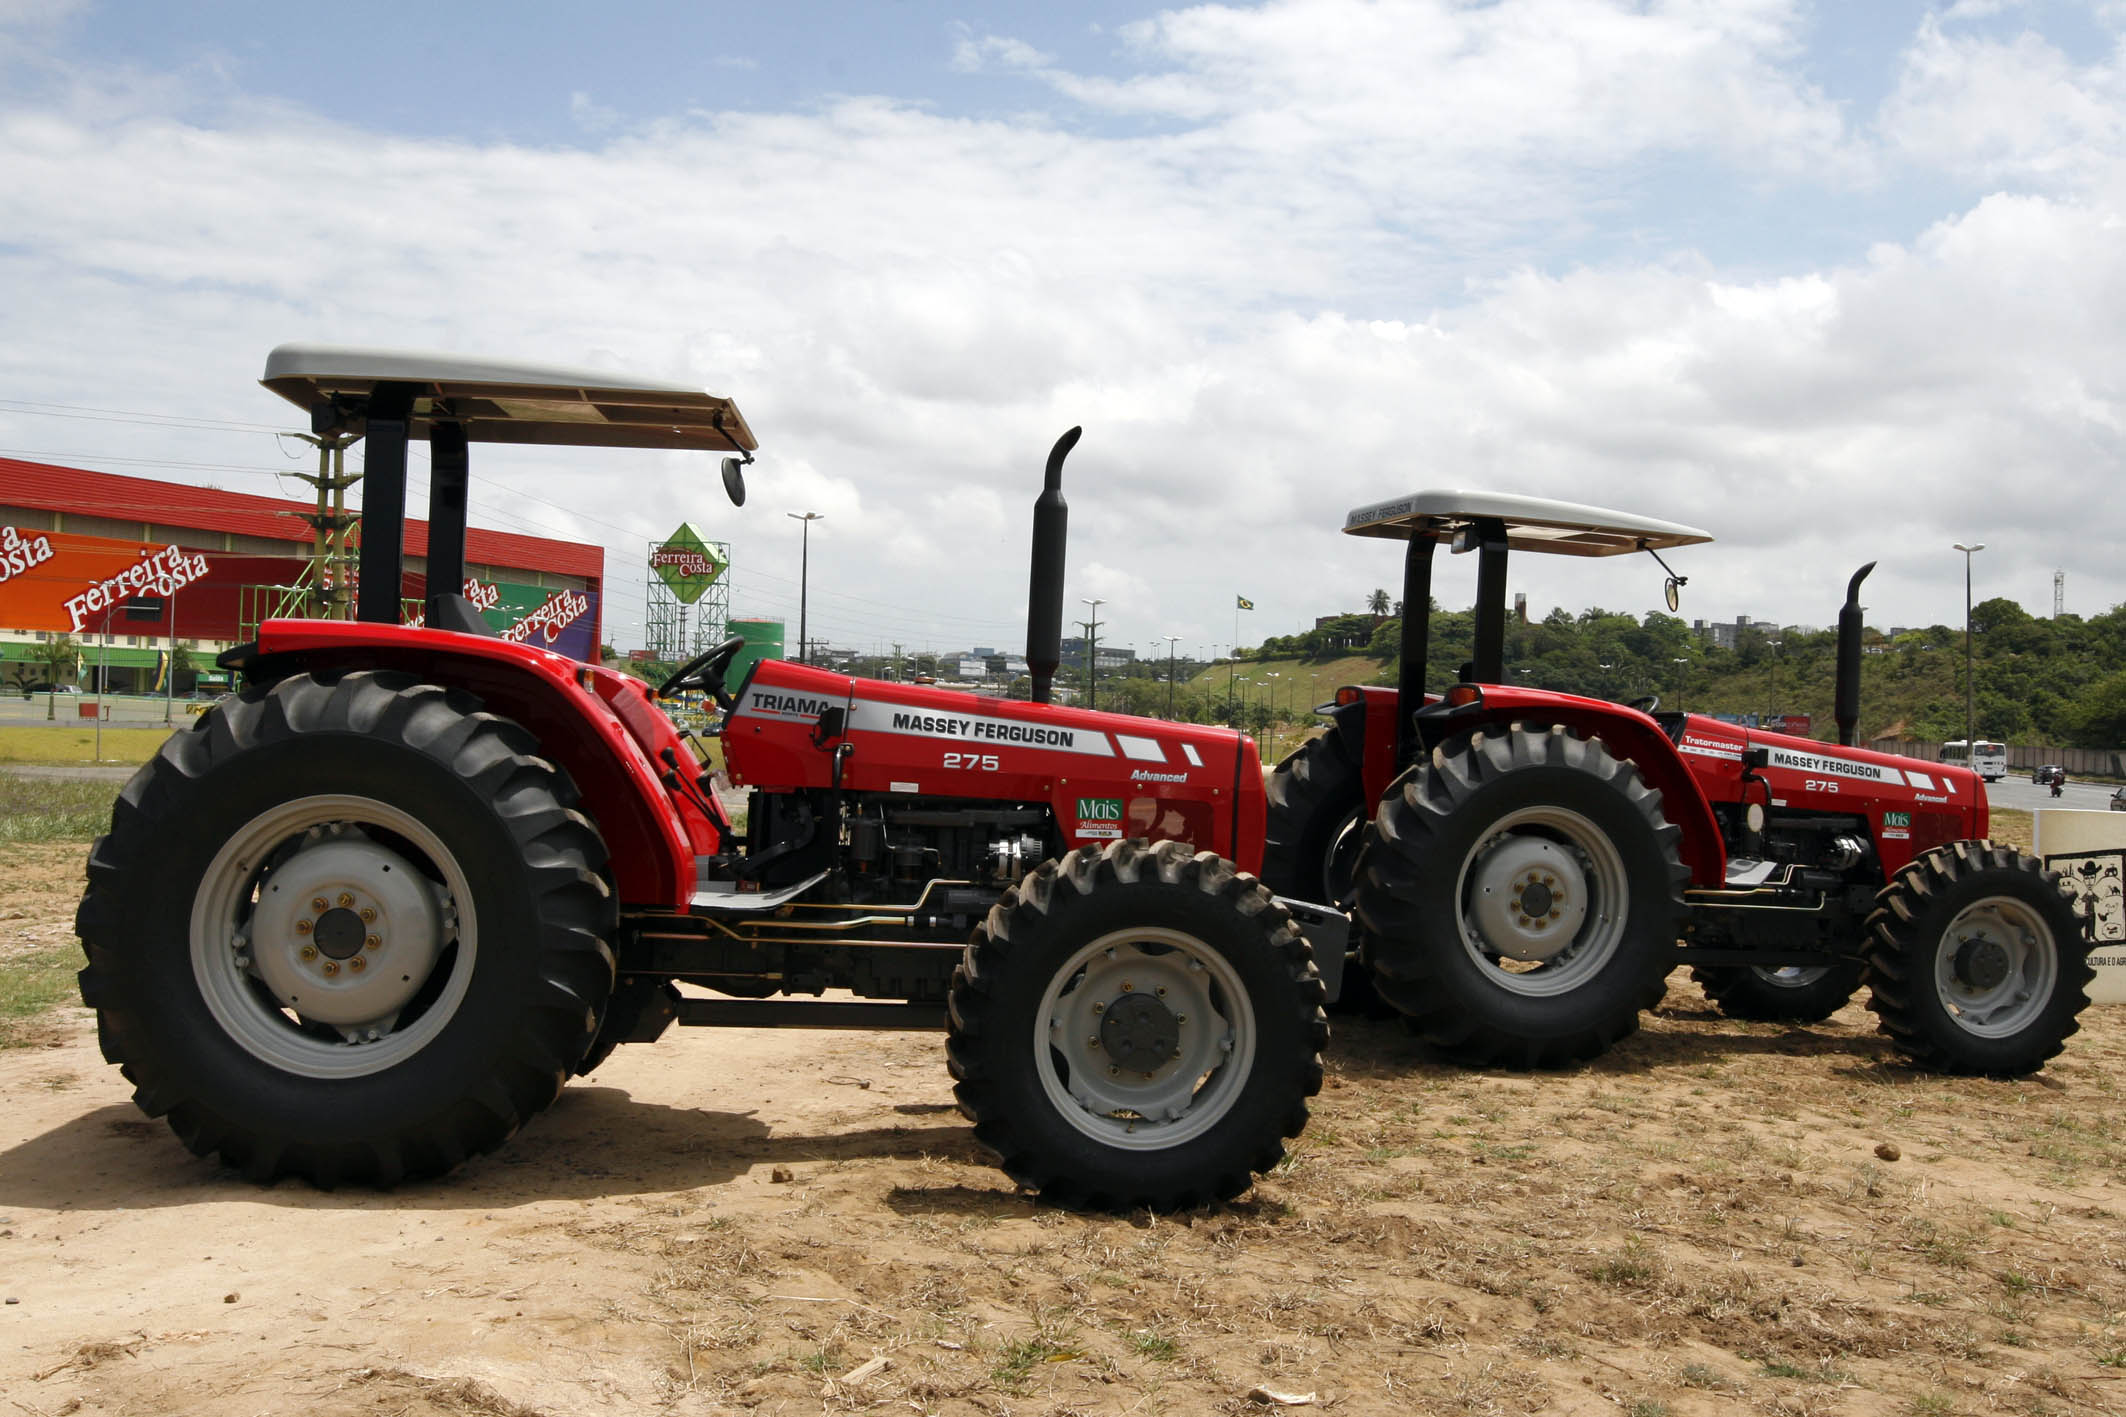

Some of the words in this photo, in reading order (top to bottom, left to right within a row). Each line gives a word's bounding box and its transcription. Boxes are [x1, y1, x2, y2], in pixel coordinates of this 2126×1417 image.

[0, 536, 54, 582] osta
[653, 553, 703, 567] Ferreira
[679, 562, 713, 577] Costa
[64, 544, 182, 633] Ferreira
[544, 595, 588, 643] Costa
[893, 713, 970, 736] MASSEY
[974, 722, 1074, 748] FERGUSON
[1685, 735, 1744, 752] Tratormaster
[943, 752, 999, 771] 275
[1774, 753, 1820, 769] MASSEY
[1822, 760, 1881, 779] FERGUSON
[1130, 769, 1188, 783] Advanced
[1805, 779, 1838, 793] 275
[1079, 799, 1119, 820] Mais
[1080, 820, 1118, 830] Alimentos
[1884, 812, 1910, 827] Mais
